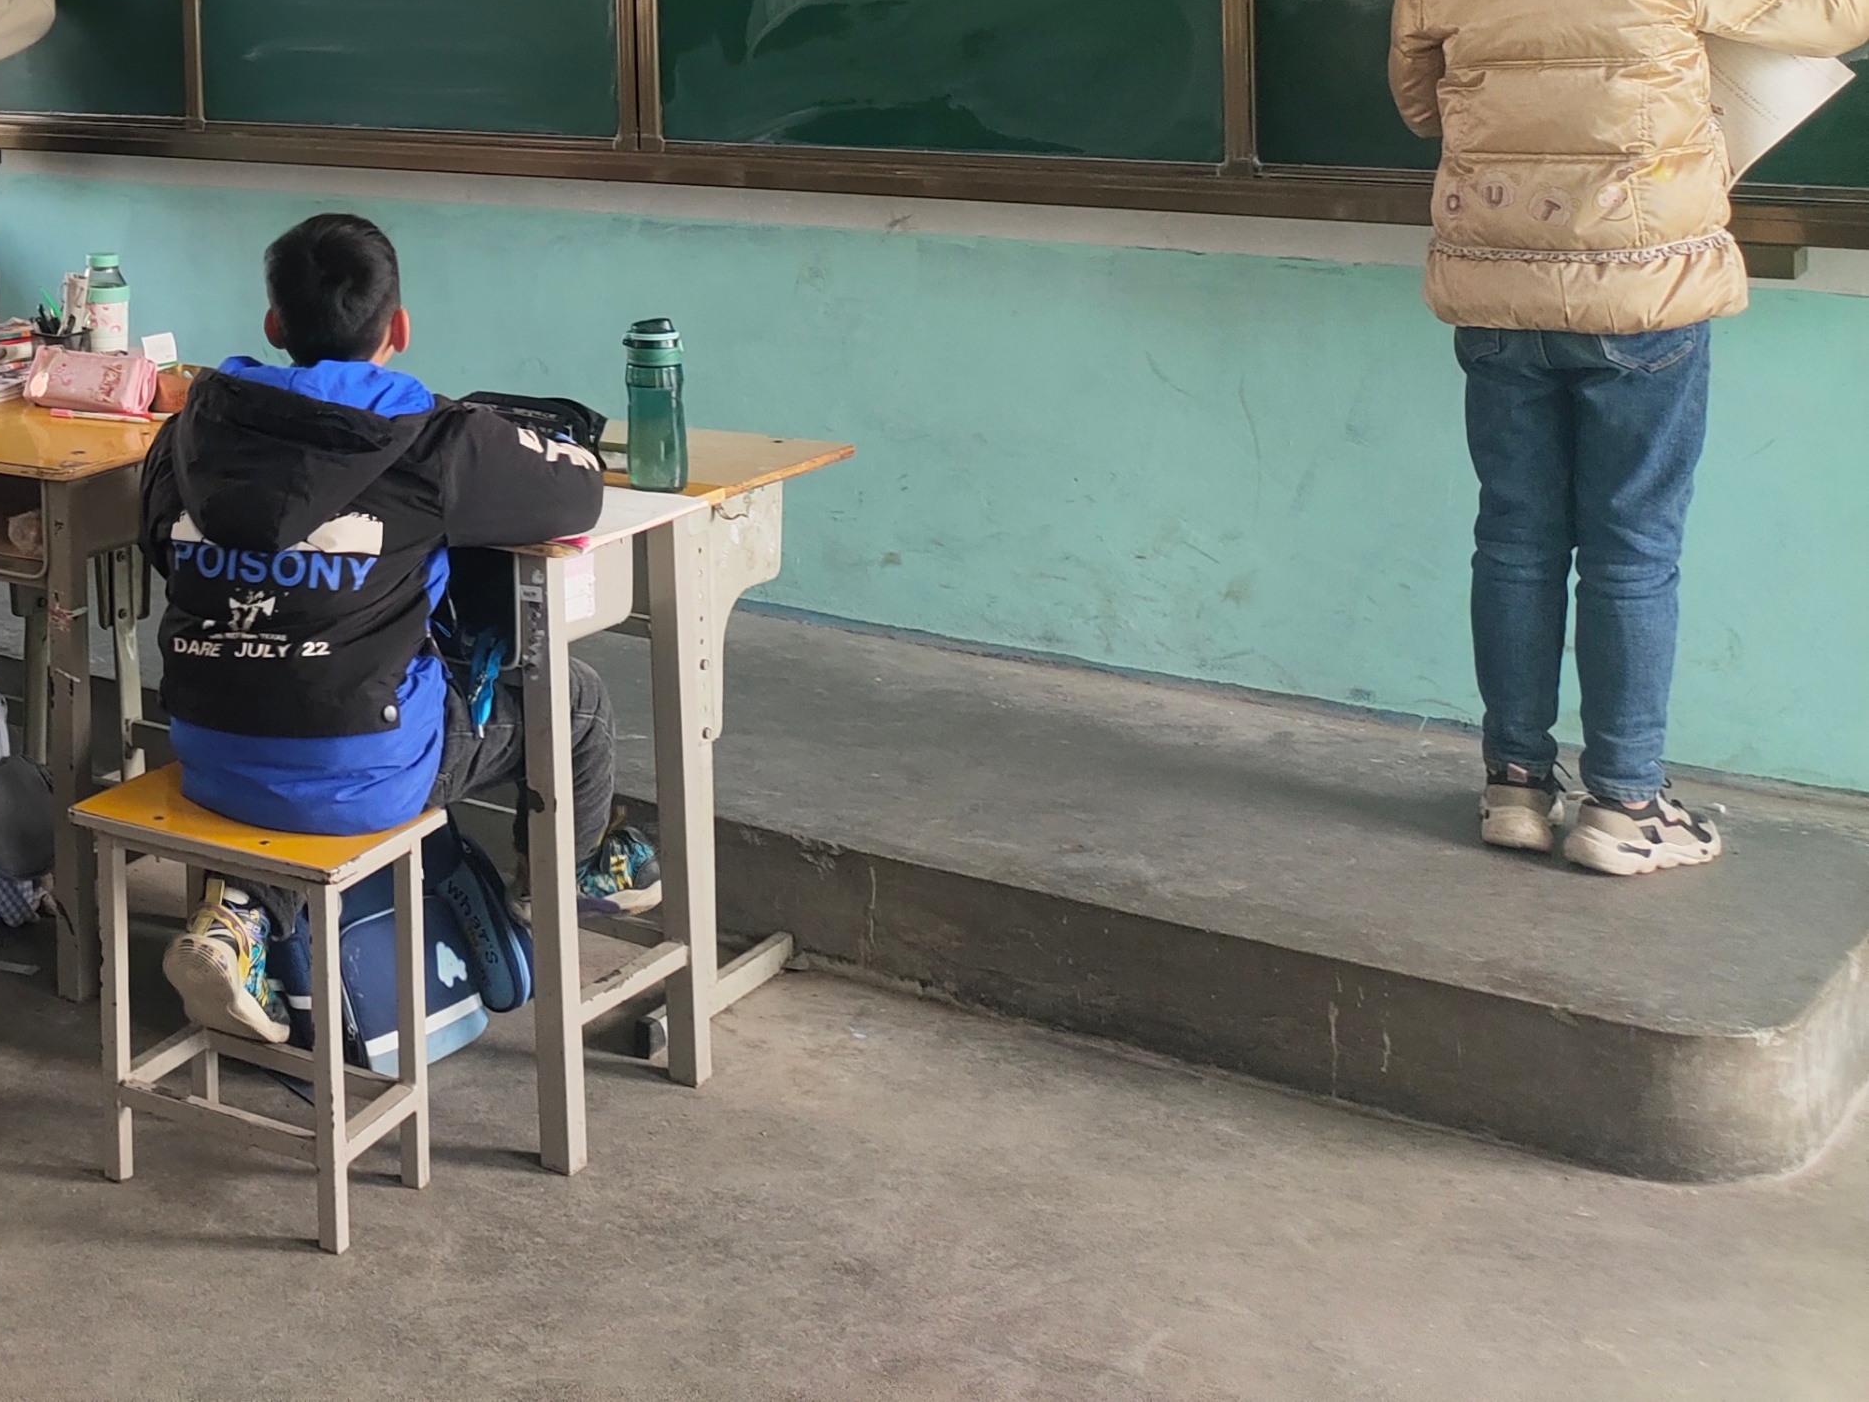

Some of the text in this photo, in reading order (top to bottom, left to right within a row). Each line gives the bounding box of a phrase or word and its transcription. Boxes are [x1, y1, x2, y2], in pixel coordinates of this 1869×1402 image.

[172, 542, 378, 591] POISONY
[173, 637, 331, 658] DARE JULY 22
